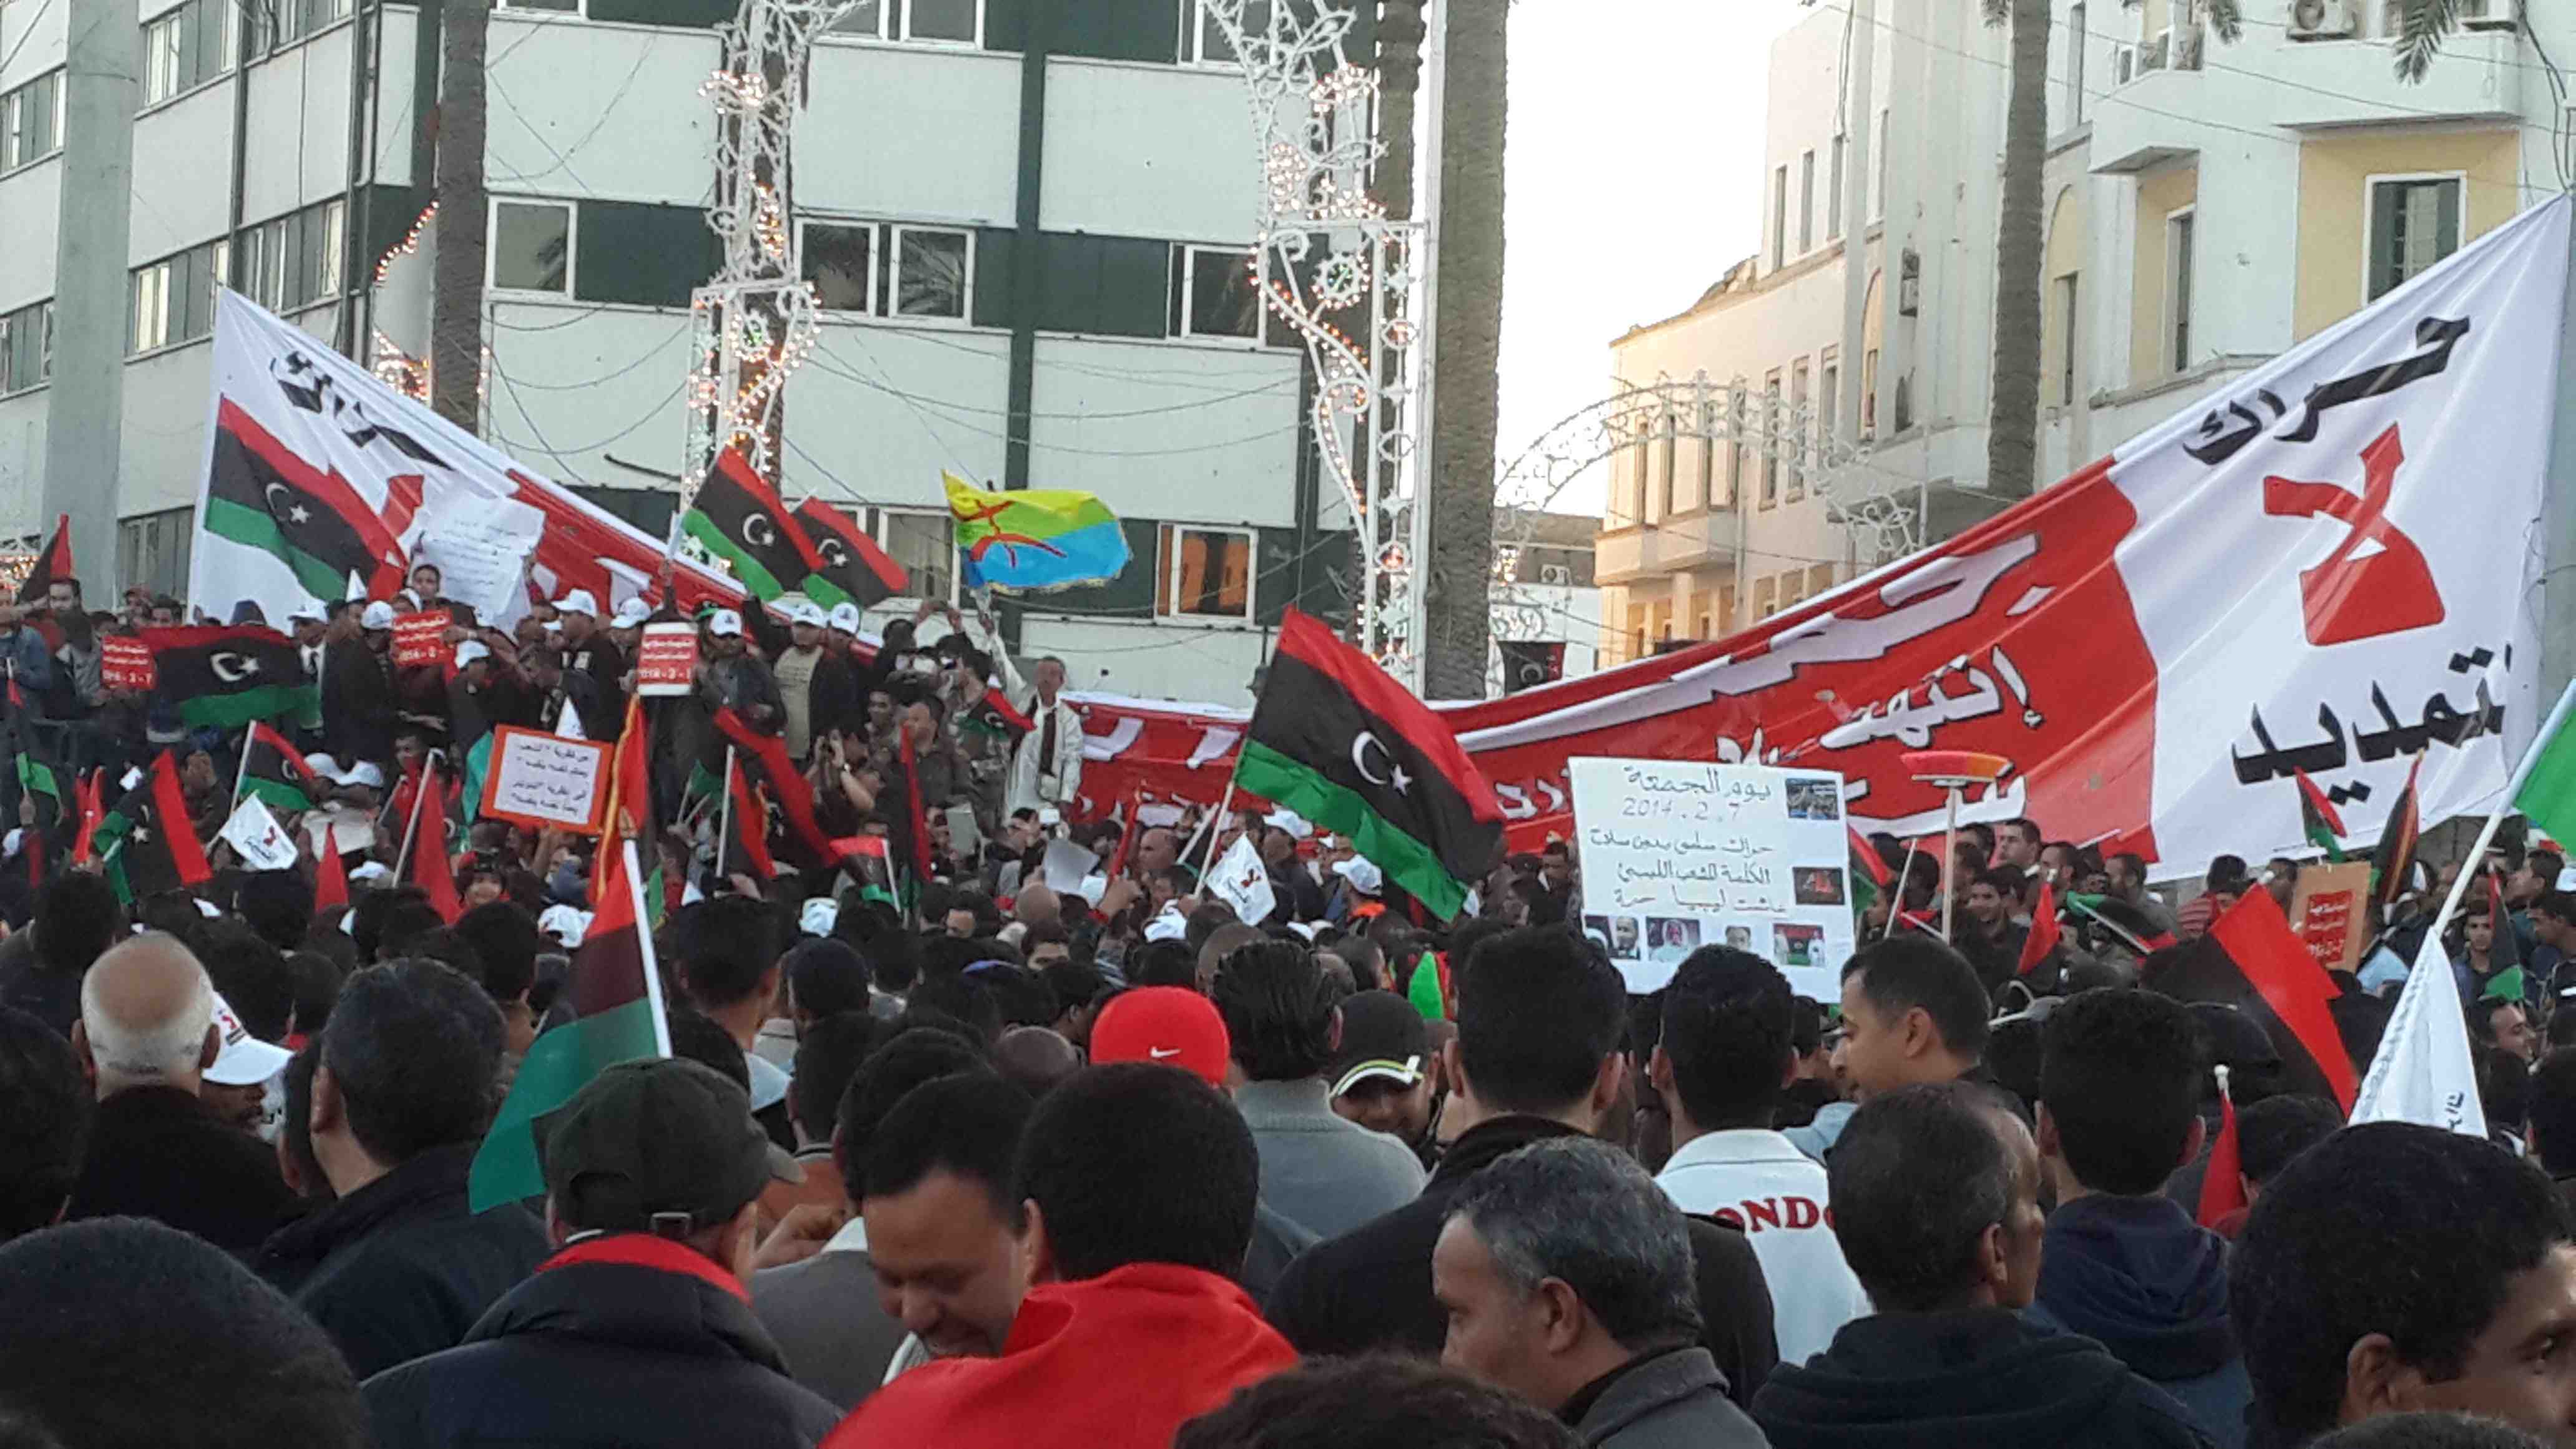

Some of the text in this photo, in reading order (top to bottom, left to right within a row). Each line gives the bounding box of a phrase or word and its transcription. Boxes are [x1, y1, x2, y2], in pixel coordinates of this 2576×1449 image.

[2182, 315, 2471, 466] حراك
[2263, 420, 2446, 646] لا
[1623, 766, 1772, 803] يوم الجمعة
